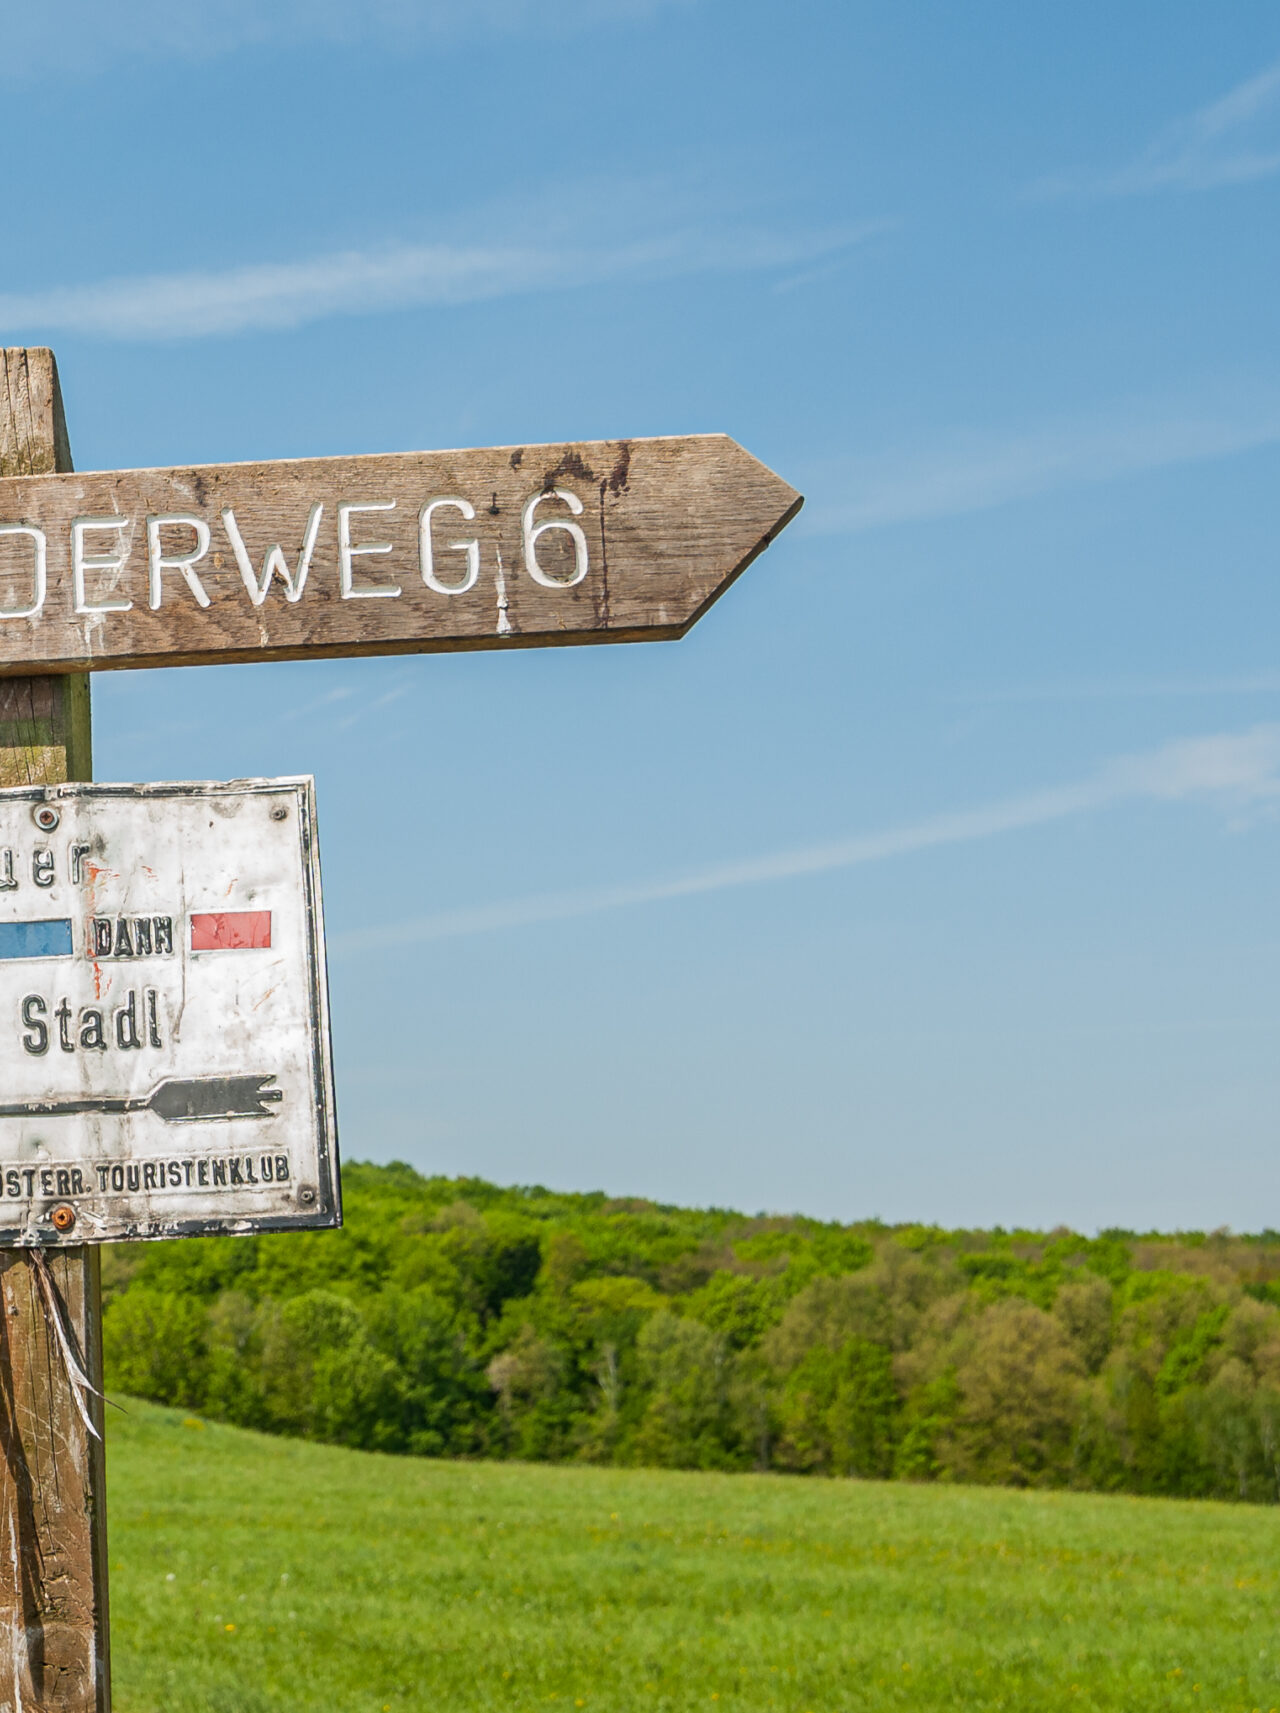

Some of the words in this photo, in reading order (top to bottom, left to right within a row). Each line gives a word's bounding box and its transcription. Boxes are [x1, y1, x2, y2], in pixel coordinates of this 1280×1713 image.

[521, 487, 589, 589] 6
[21, 989, 163, 1055] Stadl
[96, 1154, 290, 1193] TOURISTENKLUB
